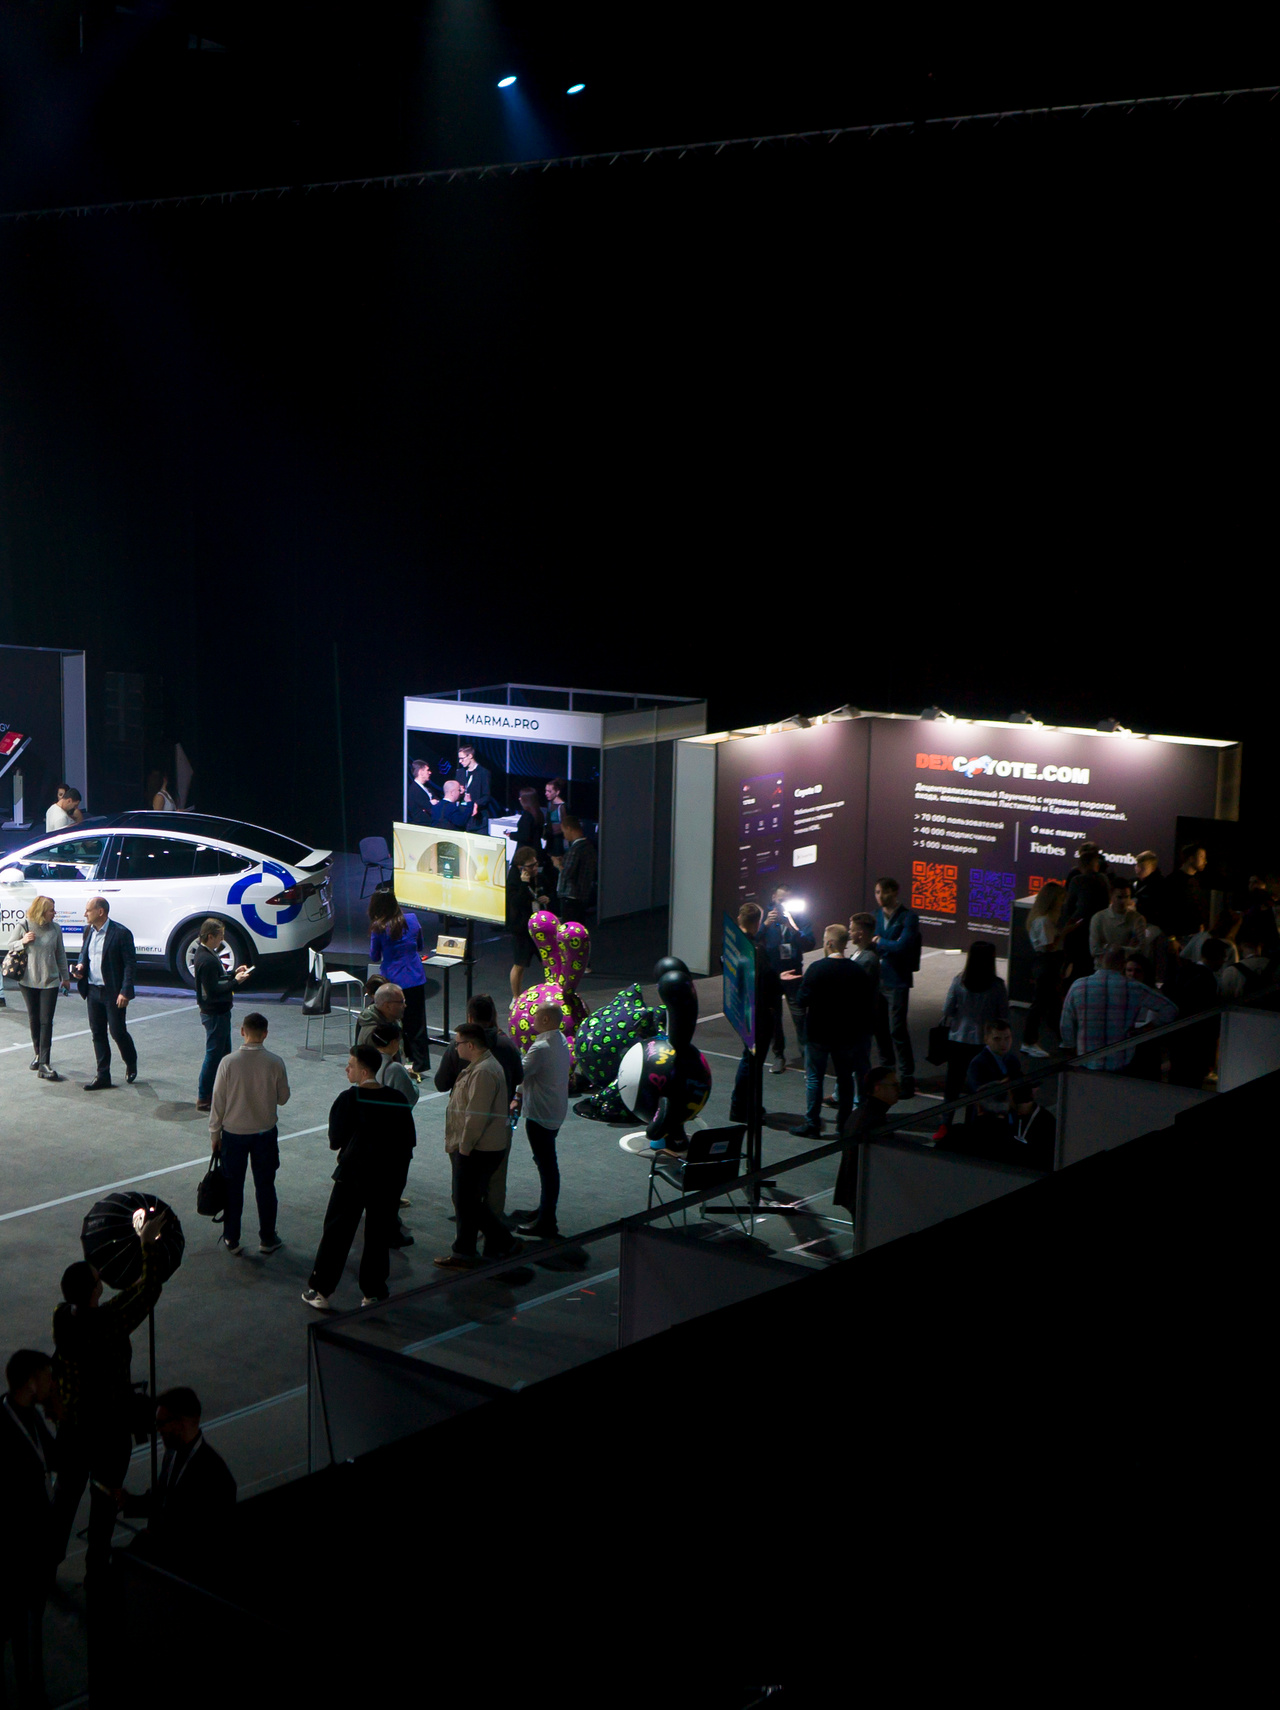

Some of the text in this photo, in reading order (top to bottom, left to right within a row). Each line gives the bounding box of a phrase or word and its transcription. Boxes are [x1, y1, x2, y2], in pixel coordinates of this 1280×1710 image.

[466, 714, 540, 731] MARMA.PRO
[1048, 805, 1080, 816] Единой
[1080, 801, 1116, 811] порогом
[921, 813, 931, 822] 70
[931, 814, 946, 823] 000
[946, 817, 1005, 830] пользователей
[920, 826, 930, 835] 40
[930, 827, 945, 836] 000
[946, 830, 997, 842] подписчиков
[919, 839, 925, 848] 5
[925, 840, 941, 849] 000
[941, 844, 978, 854] холдеров
[1030, 841, 1066, 857] Forbes
